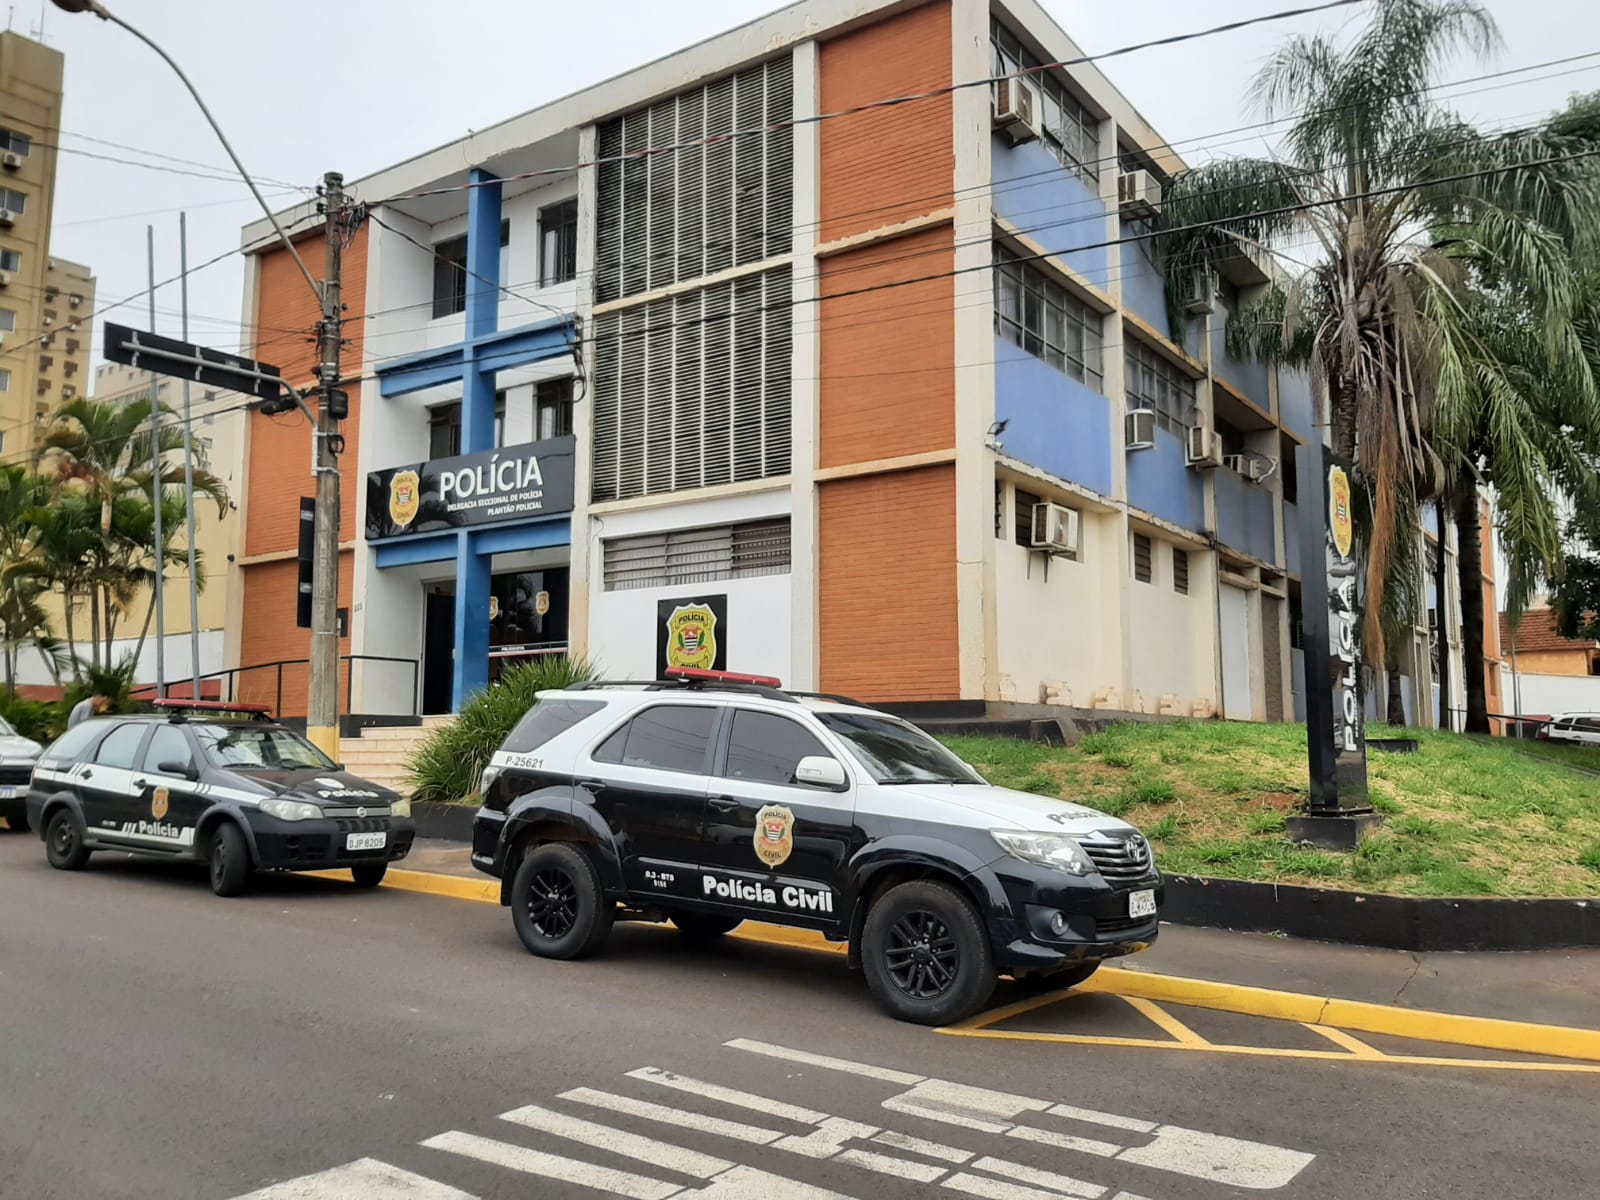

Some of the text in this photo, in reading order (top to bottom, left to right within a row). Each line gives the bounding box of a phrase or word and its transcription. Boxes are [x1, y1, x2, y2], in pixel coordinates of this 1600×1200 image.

[440, 454, 543, 501] POLÍCIA
[447, 500, 477, 512] DELEGACIA
[510, 493, 518, 502] DE
[487, 501, 542, 516] PLANTÃO POLICIAL
[1337, 576, 1358, 751] POLÍCIA
[505, 755, 544, 769] P-25621
[139, 820, 179, 838] Polícia
[703, 875, 833, 912] Polícia Civil
